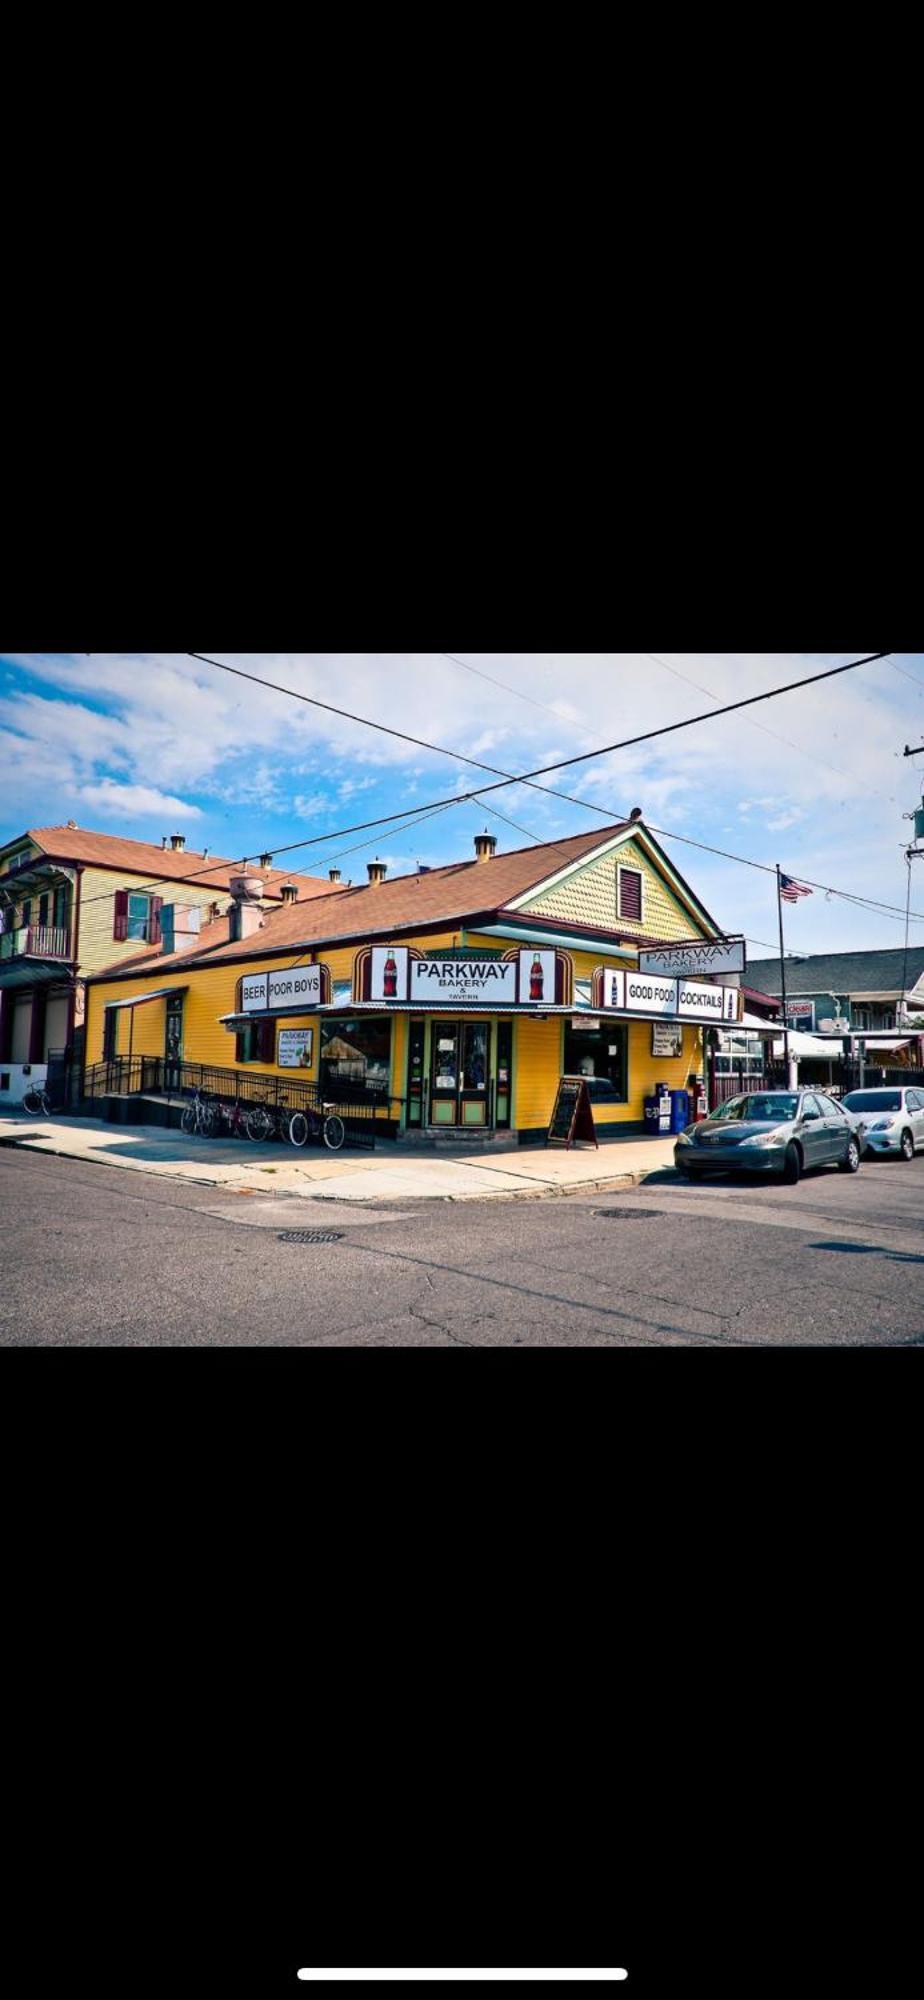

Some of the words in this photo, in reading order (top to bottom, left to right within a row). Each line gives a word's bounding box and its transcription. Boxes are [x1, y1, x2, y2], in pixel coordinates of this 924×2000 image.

[646, 945, 735, 963] PARKWAY
[663, 957, 714, 968] BAKERY
[417, 963, 509, 979] PARKWAY
[268, 982, 293, 997] POOR
[294, 978, 320, 993] BOYS
[438, 979, 488, 987] BAKERY
[244, 985, 266, 1000] BEER
[629, 984, 653, 1000] GOOD
[654, 987, 676, 1002] FOOD
[679, 991, 723, 1008] COCKTAILS
